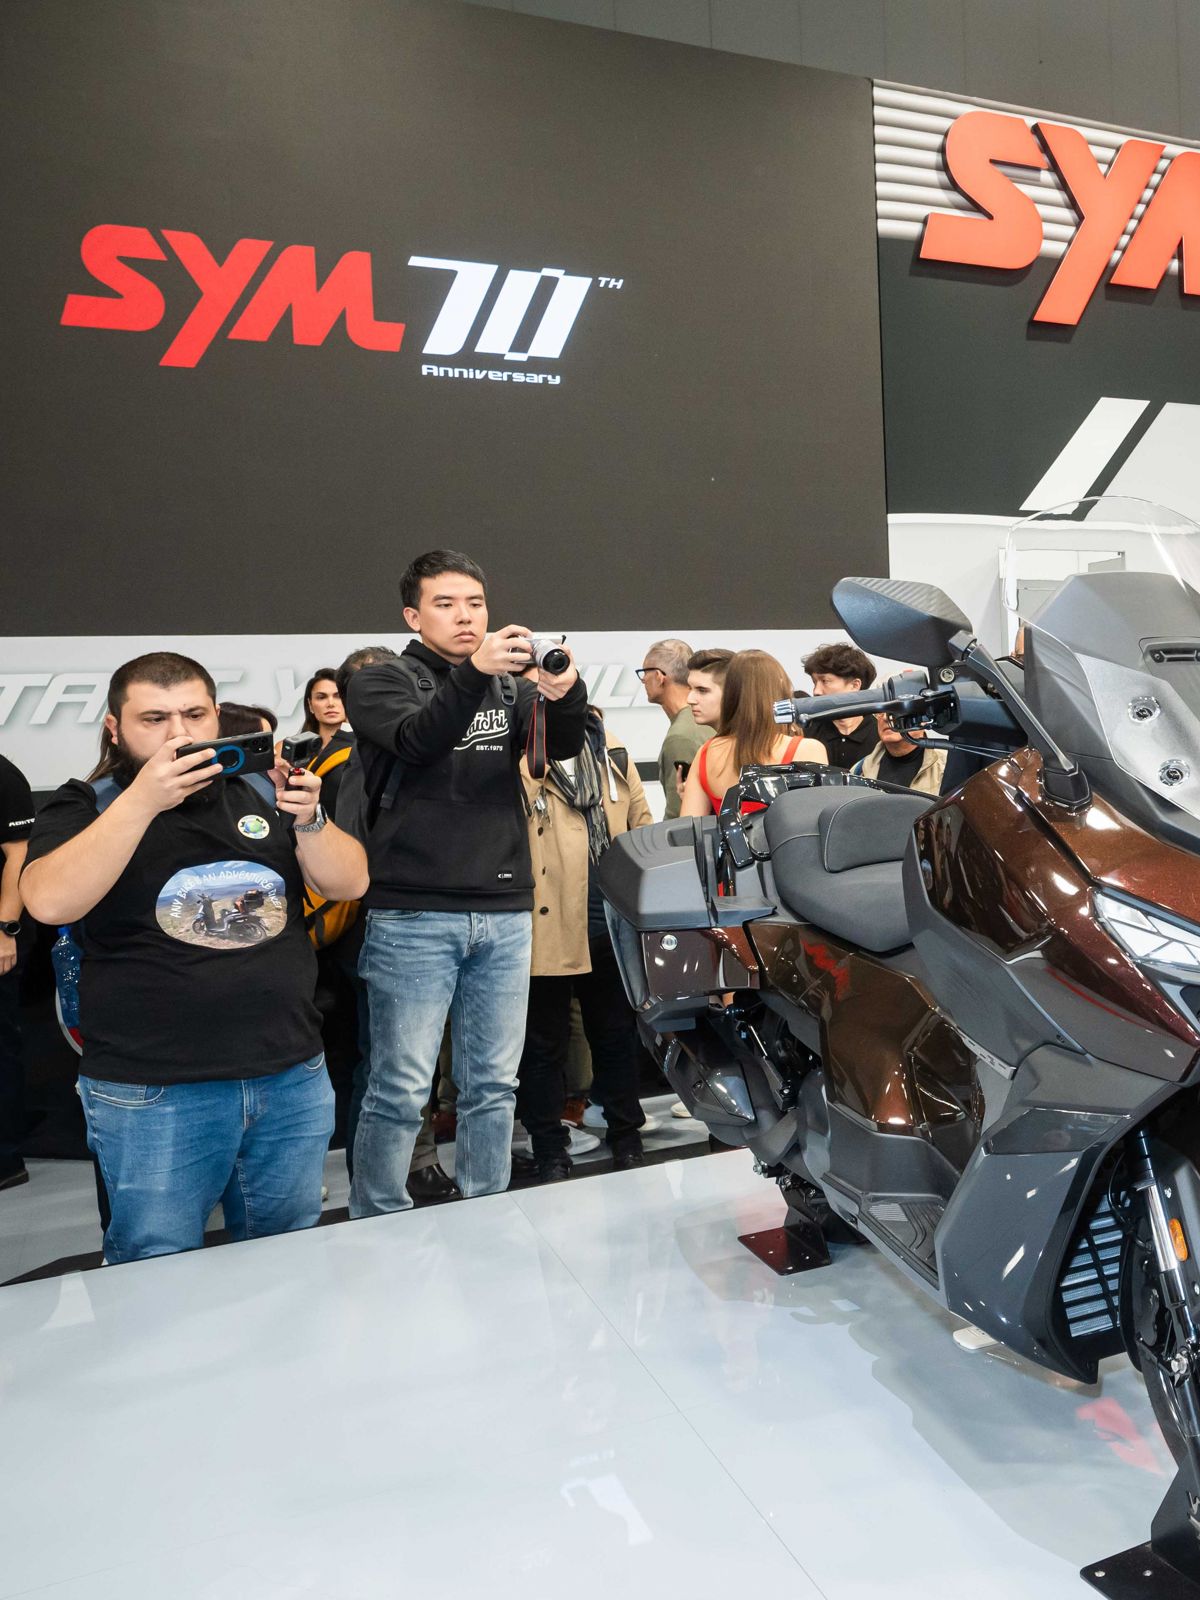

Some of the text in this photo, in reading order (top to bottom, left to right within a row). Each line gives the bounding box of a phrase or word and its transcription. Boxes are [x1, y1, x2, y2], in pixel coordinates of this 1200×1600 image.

[60, 224, 406, 368] SYM
[422, 364, 561, 385] Anniversary
[170, 898, 184, 919] ANY
[219, 870, 274, 890] ADVENTURE
